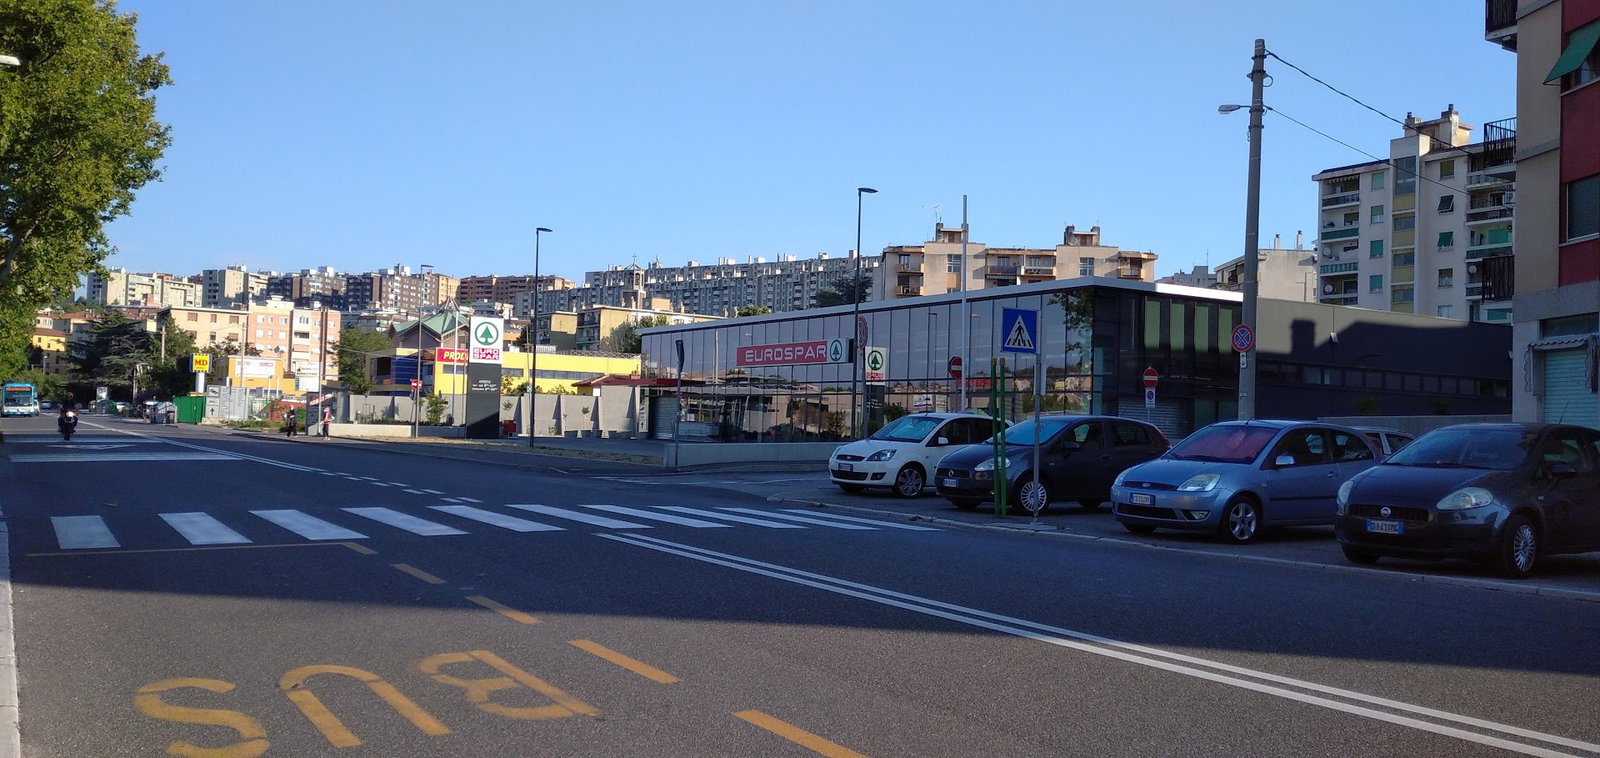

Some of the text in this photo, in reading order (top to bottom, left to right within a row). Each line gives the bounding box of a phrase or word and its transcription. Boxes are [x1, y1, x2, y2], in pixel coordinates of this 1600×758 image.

[745, 344, 827, 362] EUROSPAR
[194, 358, 208, 367] MD
[134, 650, 599, 758] BUS
